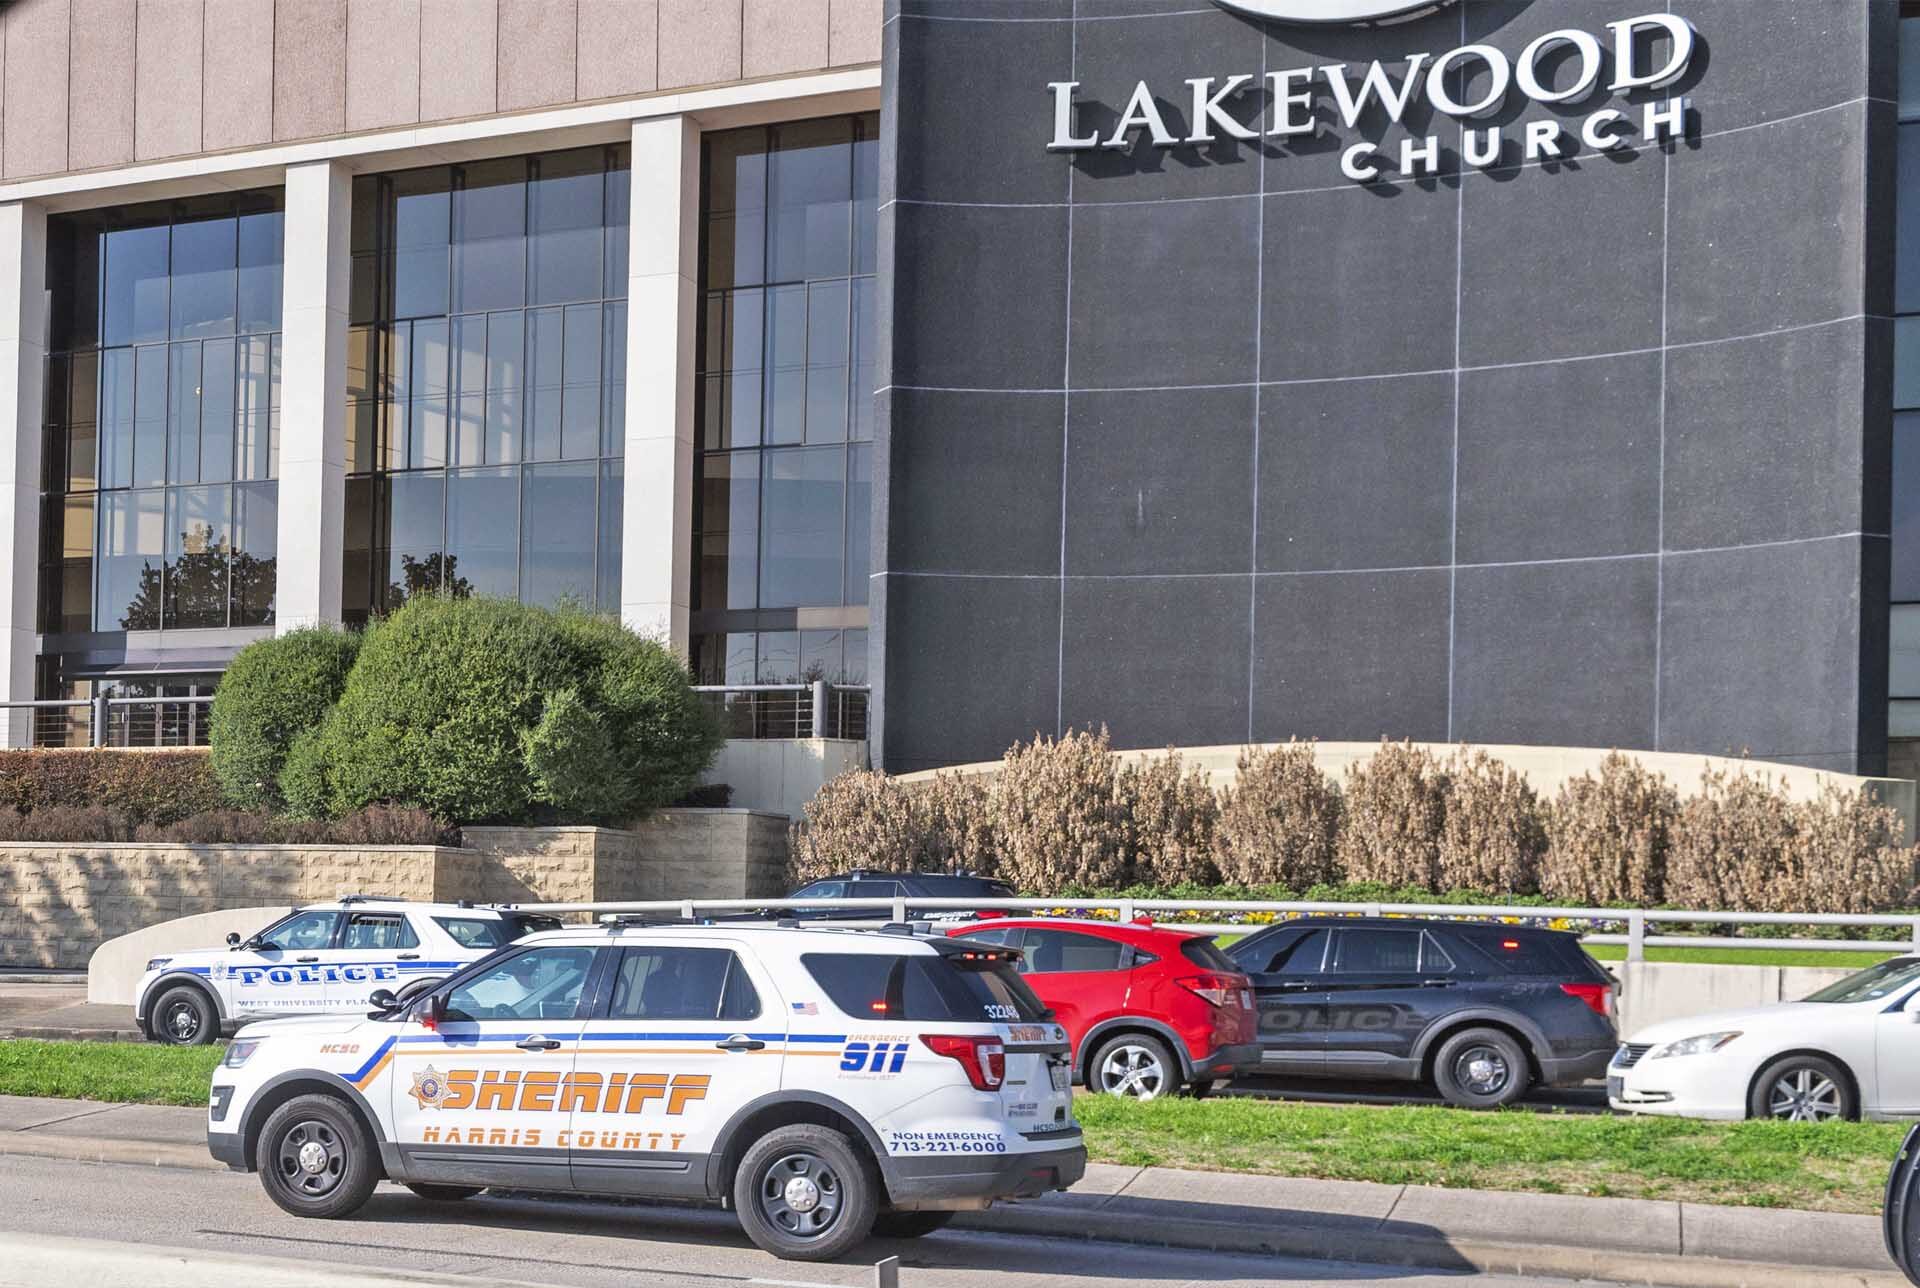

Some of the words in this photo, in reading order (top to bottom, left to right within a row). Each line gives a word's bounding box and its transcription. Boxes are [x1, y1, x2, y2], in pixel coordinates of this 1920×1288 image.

[1047, 13, 1695, 151] LAKEWOOD
[1341, 97, 1688, 181] CHURCH
[238, 965, 398, 986] POLICE
[1256, 1009, 1426, 1030] OLICE
[848, 1034, 911, 1042] EMERGENCY
[840, 1042, 910, 1073] 911
[441, 1070, 712, 1115] SHERIFF
[422, 1126, 543, 1146] HARRIS
[556, 1130, 687, 1150] COUNTY
[889, 1142, 1006, 1152] 713-221-6000
[892, 1132, 924, 1141] NON
[927, 1132, 1002, 1142] EMERGENCY
